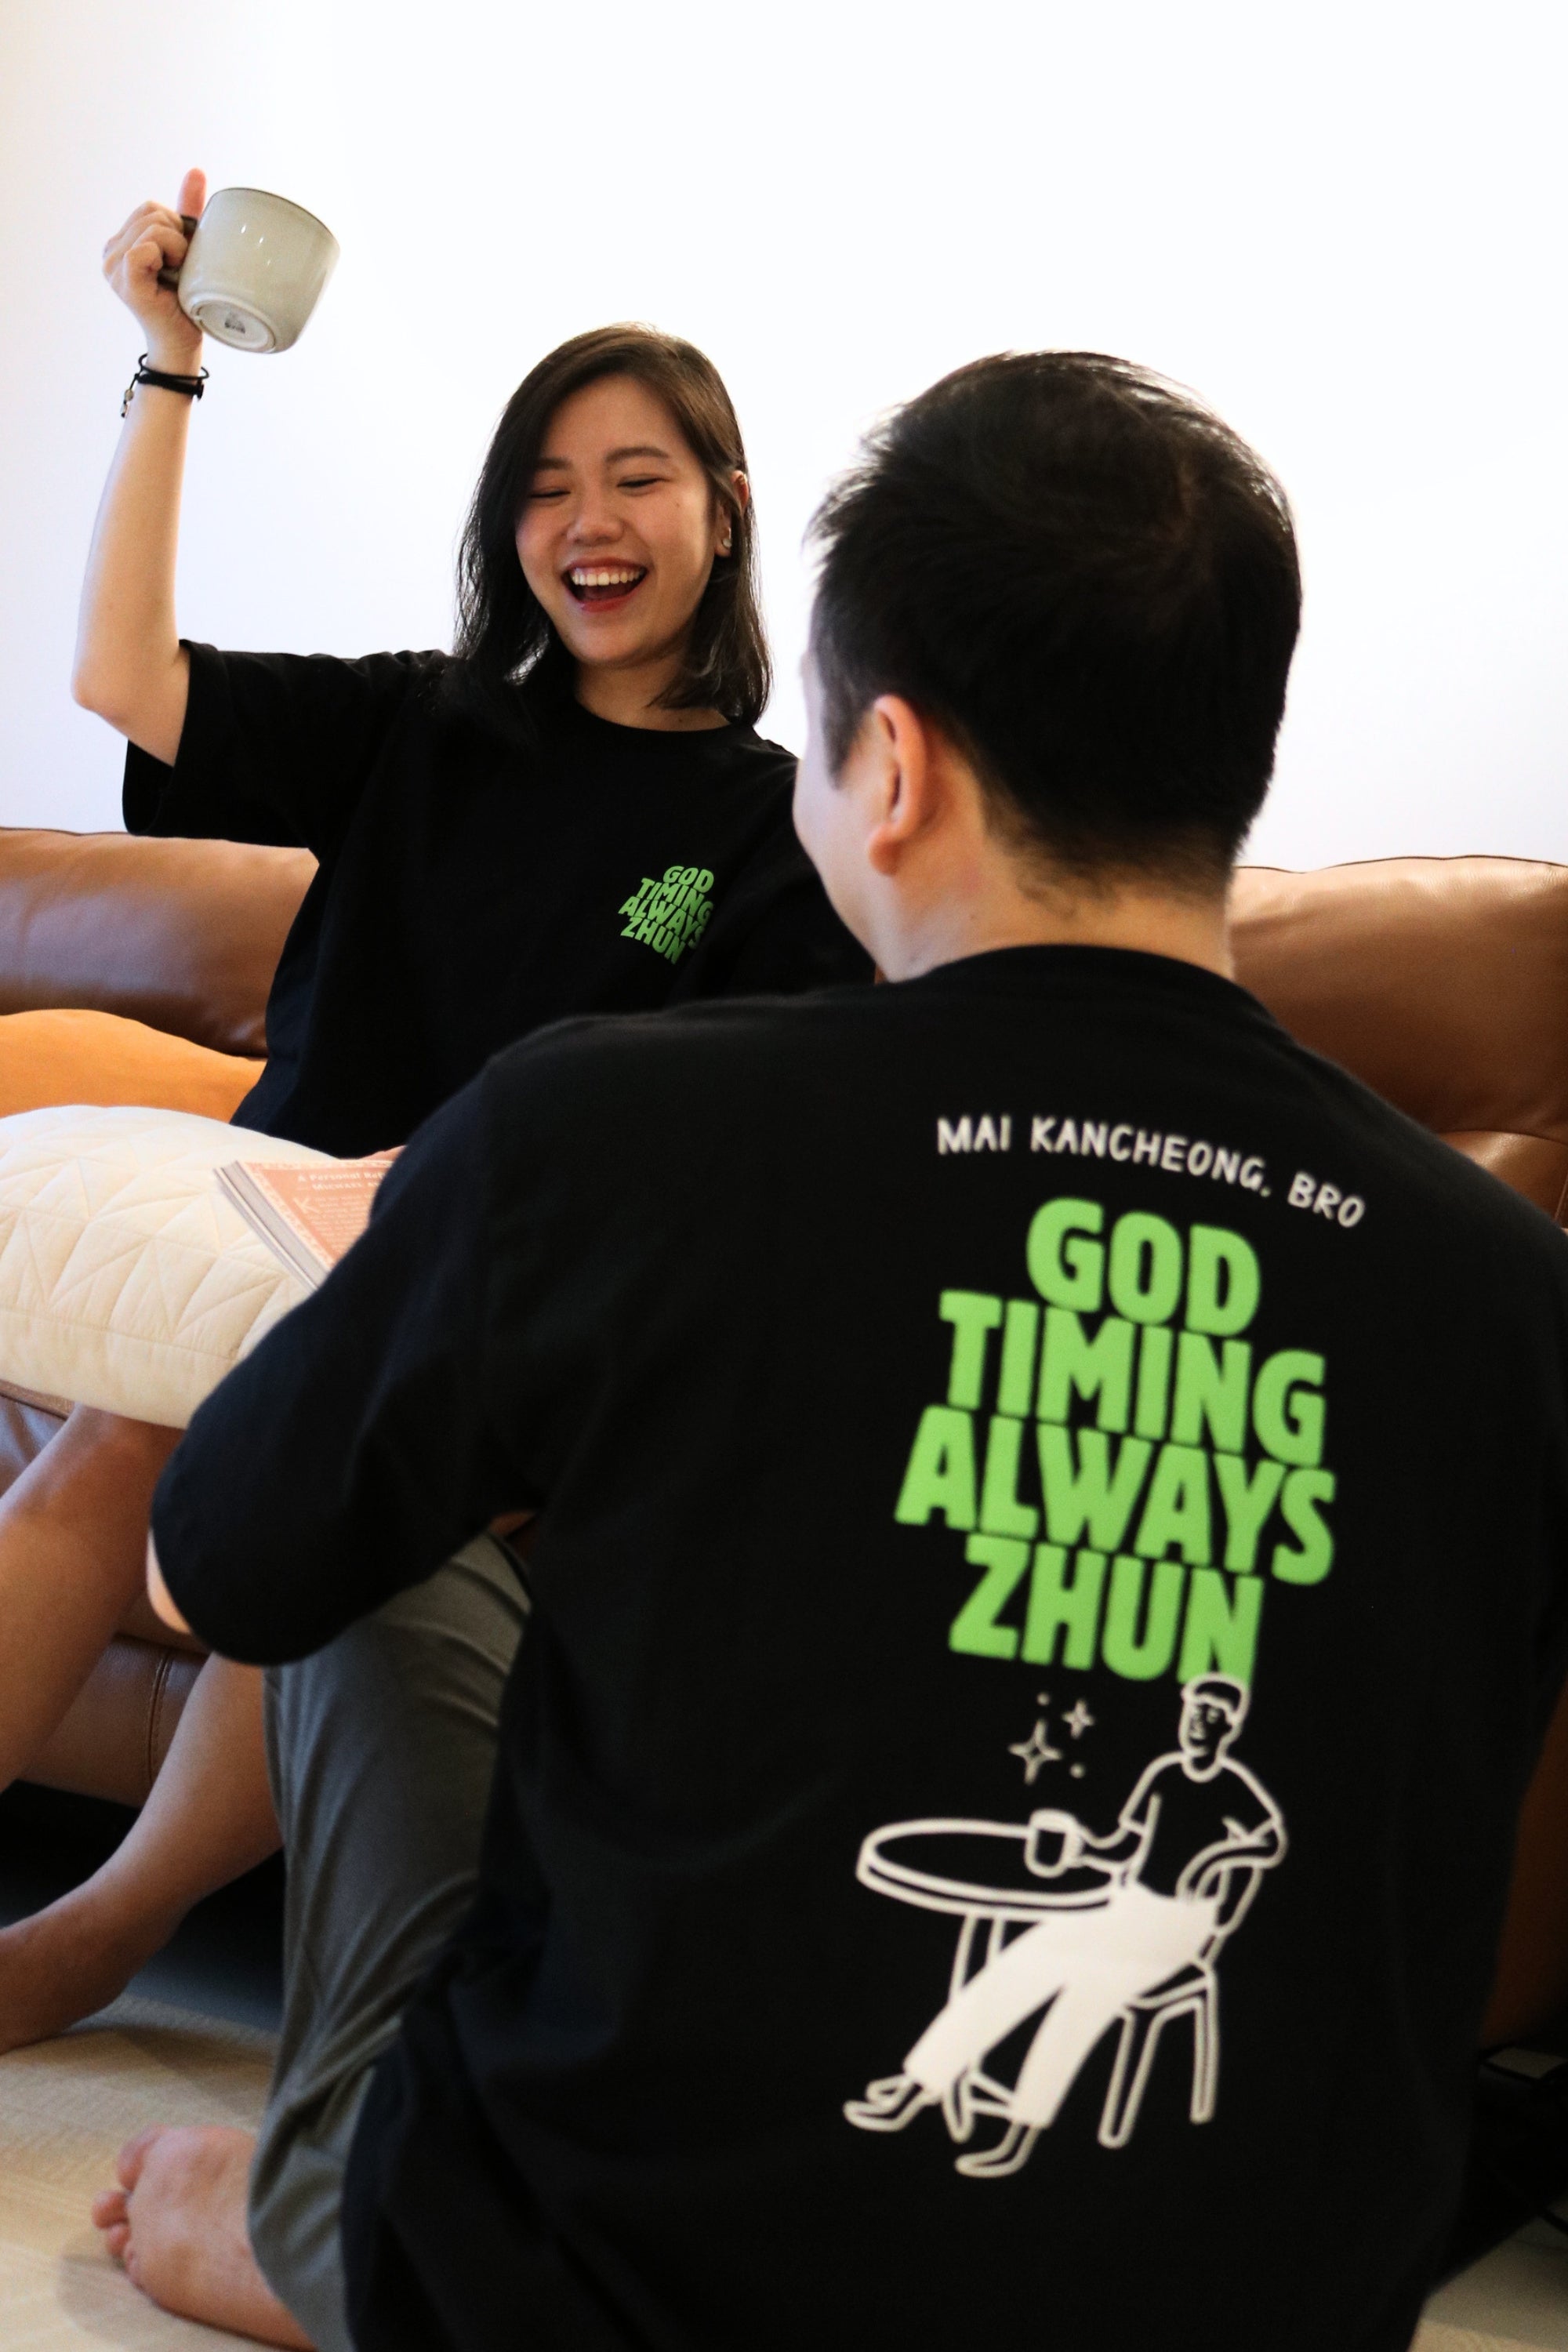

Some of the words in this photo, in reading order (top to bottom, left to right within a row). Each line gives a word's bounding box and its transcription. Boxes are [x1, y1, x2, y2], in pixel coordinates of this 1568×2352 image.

[618, 895, 704, 949] ALWAYS
[637, 877, 713, 926] TIMING
[663, 866, 714, 893] GOD
[620, 916, 686, 964] ZHUN
[937, 1116, 1011, 1155] MAI
[1287, 1172, 1365, 1228] BRO
[1026, 1196, 1261, 1337] GOD
[939, 1290, 1326, 1468] TIMING
[894, 1405, 1336, 1585] ALWAYS
[949, 1533, 1264, 1688] ZHUN
